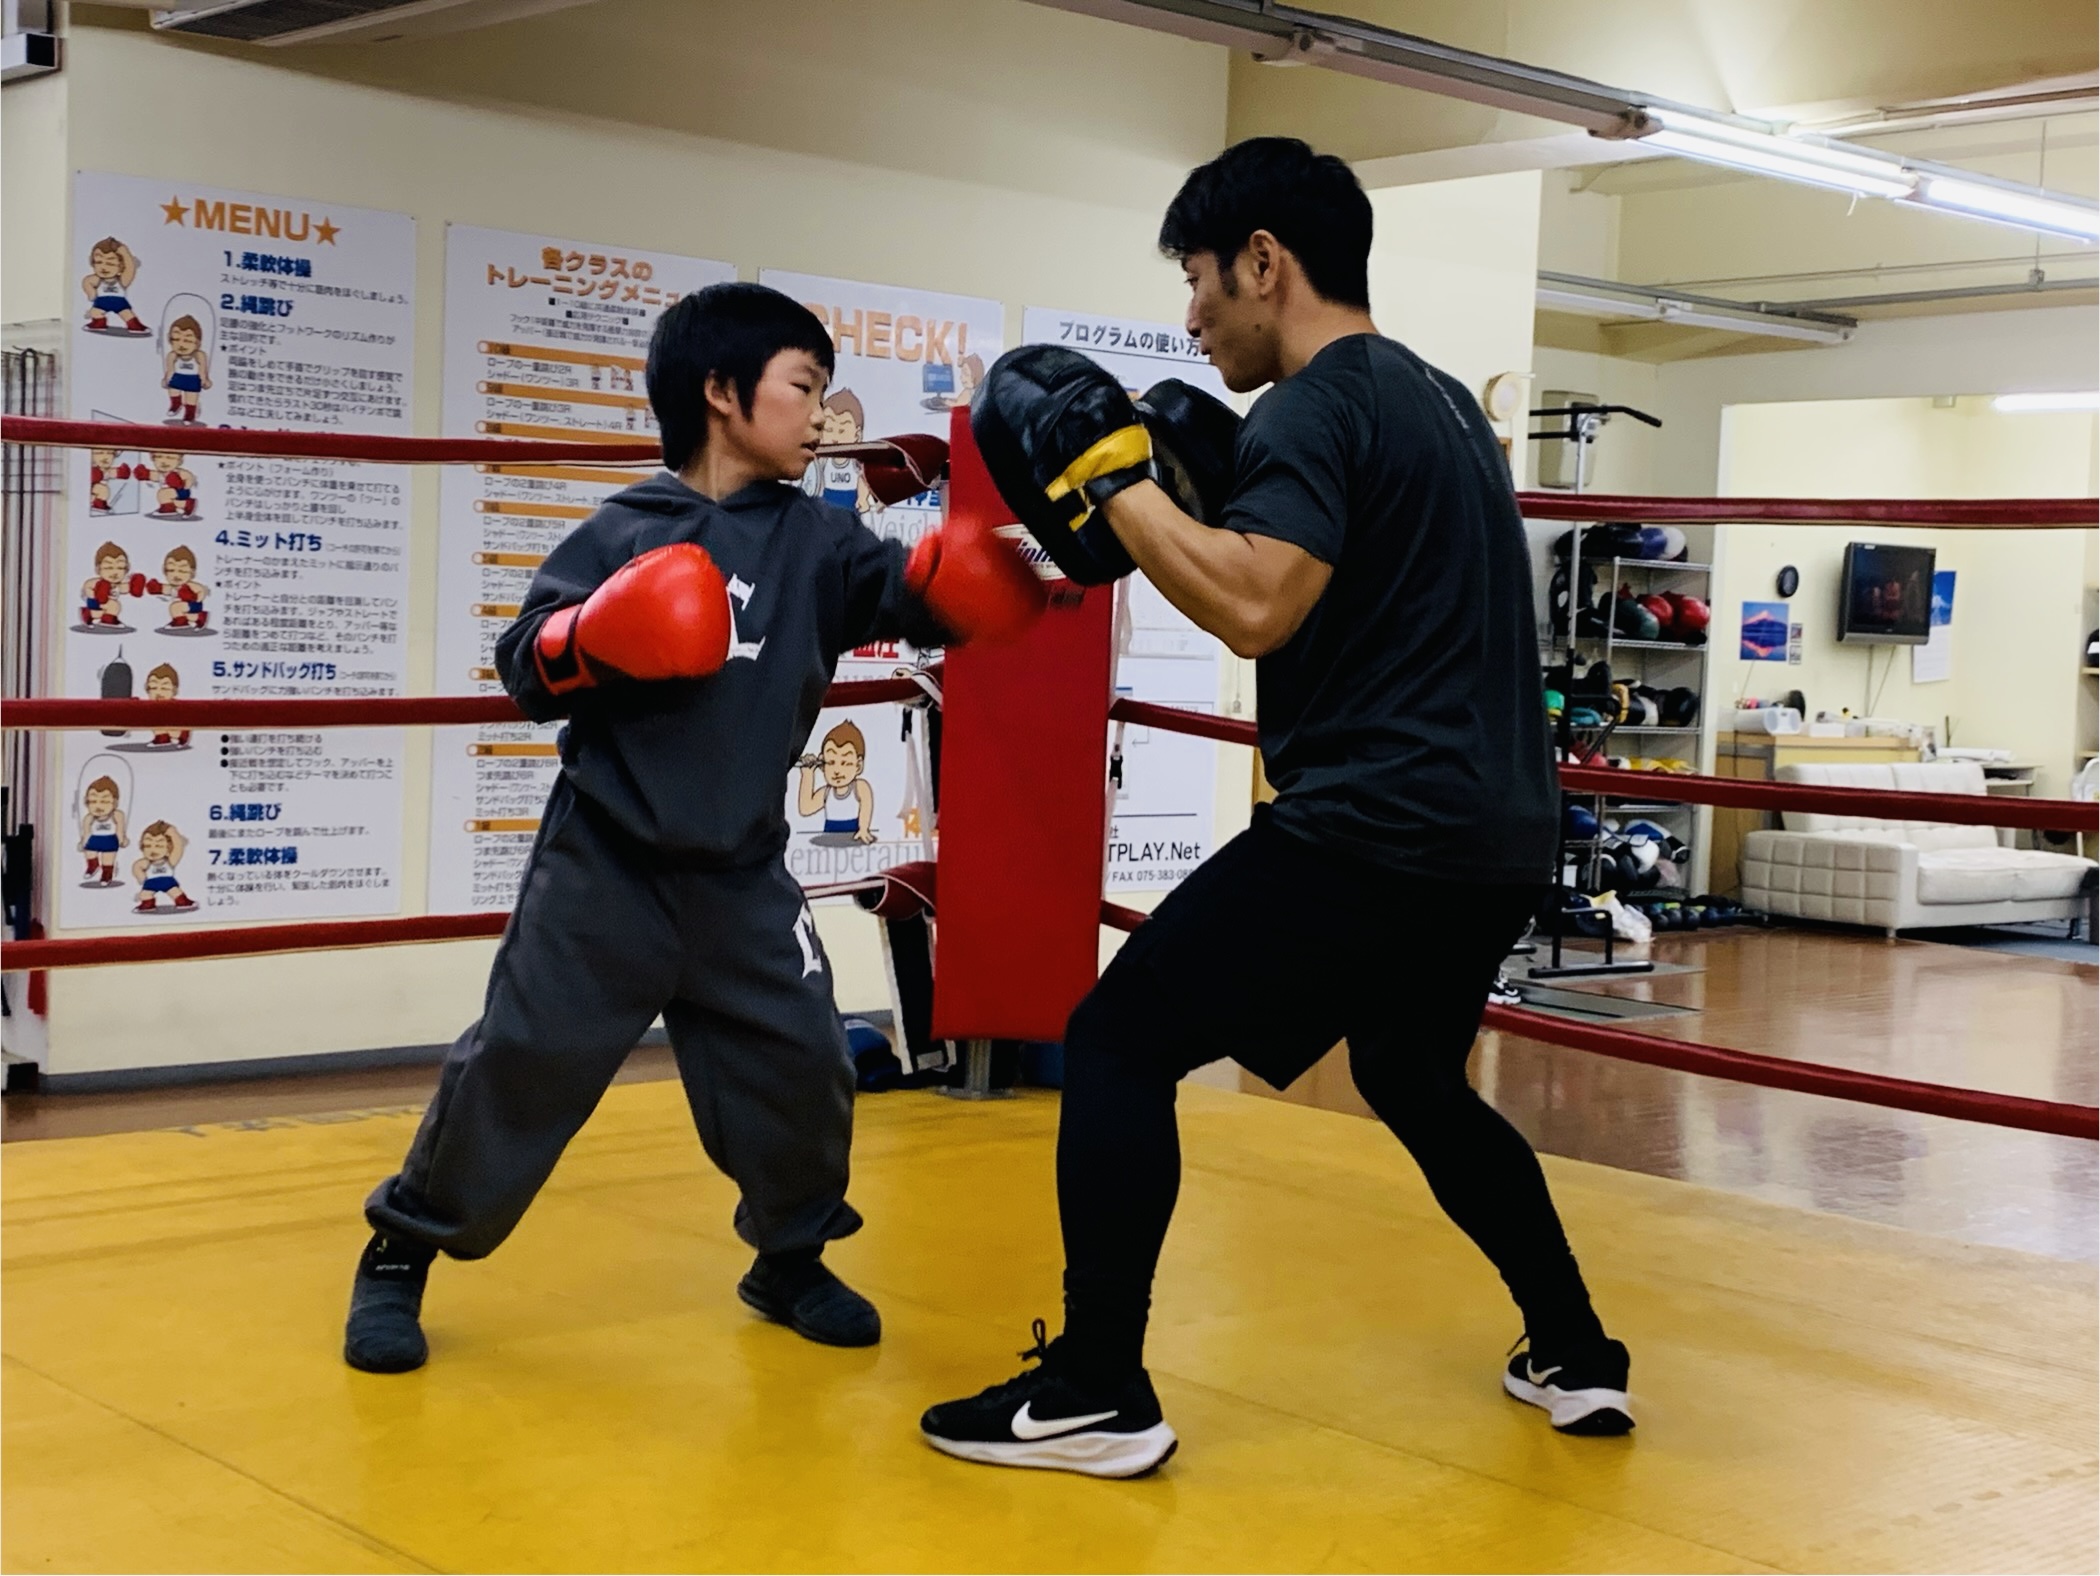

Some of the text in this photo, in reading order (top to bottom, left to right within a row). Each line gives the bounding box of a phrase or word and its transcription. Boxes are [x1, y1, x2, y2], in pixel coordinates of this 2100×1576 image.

[194, 198, 310, 242] MENU
[224, 251, 311, 278] 1.柔軟体操
[541, 246, 653, 281] 各クラスの
[220, 294, 293, 317] 2.縄跳び
[831, 472, 850, 483] UNO
[215, 530, 322, 551] 4.ミット打ち
[213, 661, 336, 680] 5.サンドバッグ打ち
[209, 803, 282, 821] 6.縄跳び
[208, 846, 298, 866] 7.柔軟体操
[1113, 871, 1133, 882] FAX
